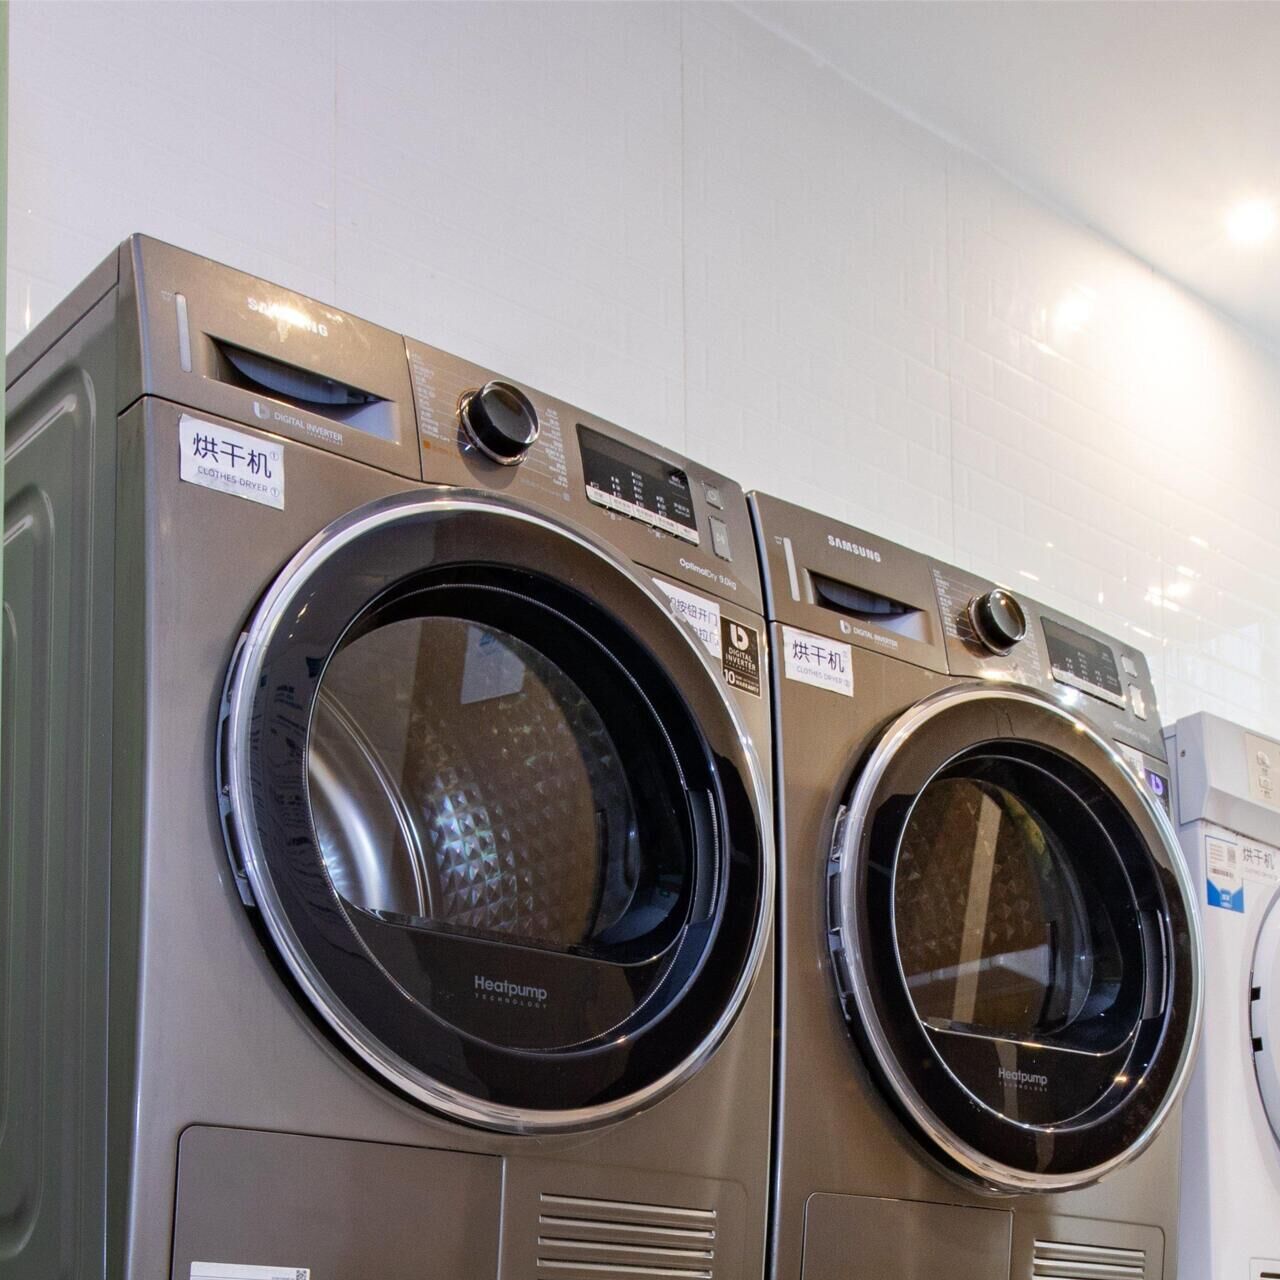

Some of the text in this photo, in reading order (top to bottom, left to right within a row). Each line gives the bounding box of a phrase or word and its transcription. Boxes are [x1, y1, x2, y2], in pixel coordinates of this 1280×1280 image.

[274, 412, 306, 429] DIGITAL
[306, 422, 343, 442] INVERTER
[193, 433, 271, 479] 烘干机
[198, 466, 238, 485] CLOTHES
[239, 477, 268, 493] DRYER
[827, 535, 881, 563] SAMSUNG
[725, 653, 756, 671] INVERTER
[728, 647, 753, 662] DIGITAL
[792, 640, 844, 673] 烘干机
[724, 669, 736, 684] 10
[474, 975, 548, 1001] Heatpump
[998, 1067, 1048, 1086] Heatpump
